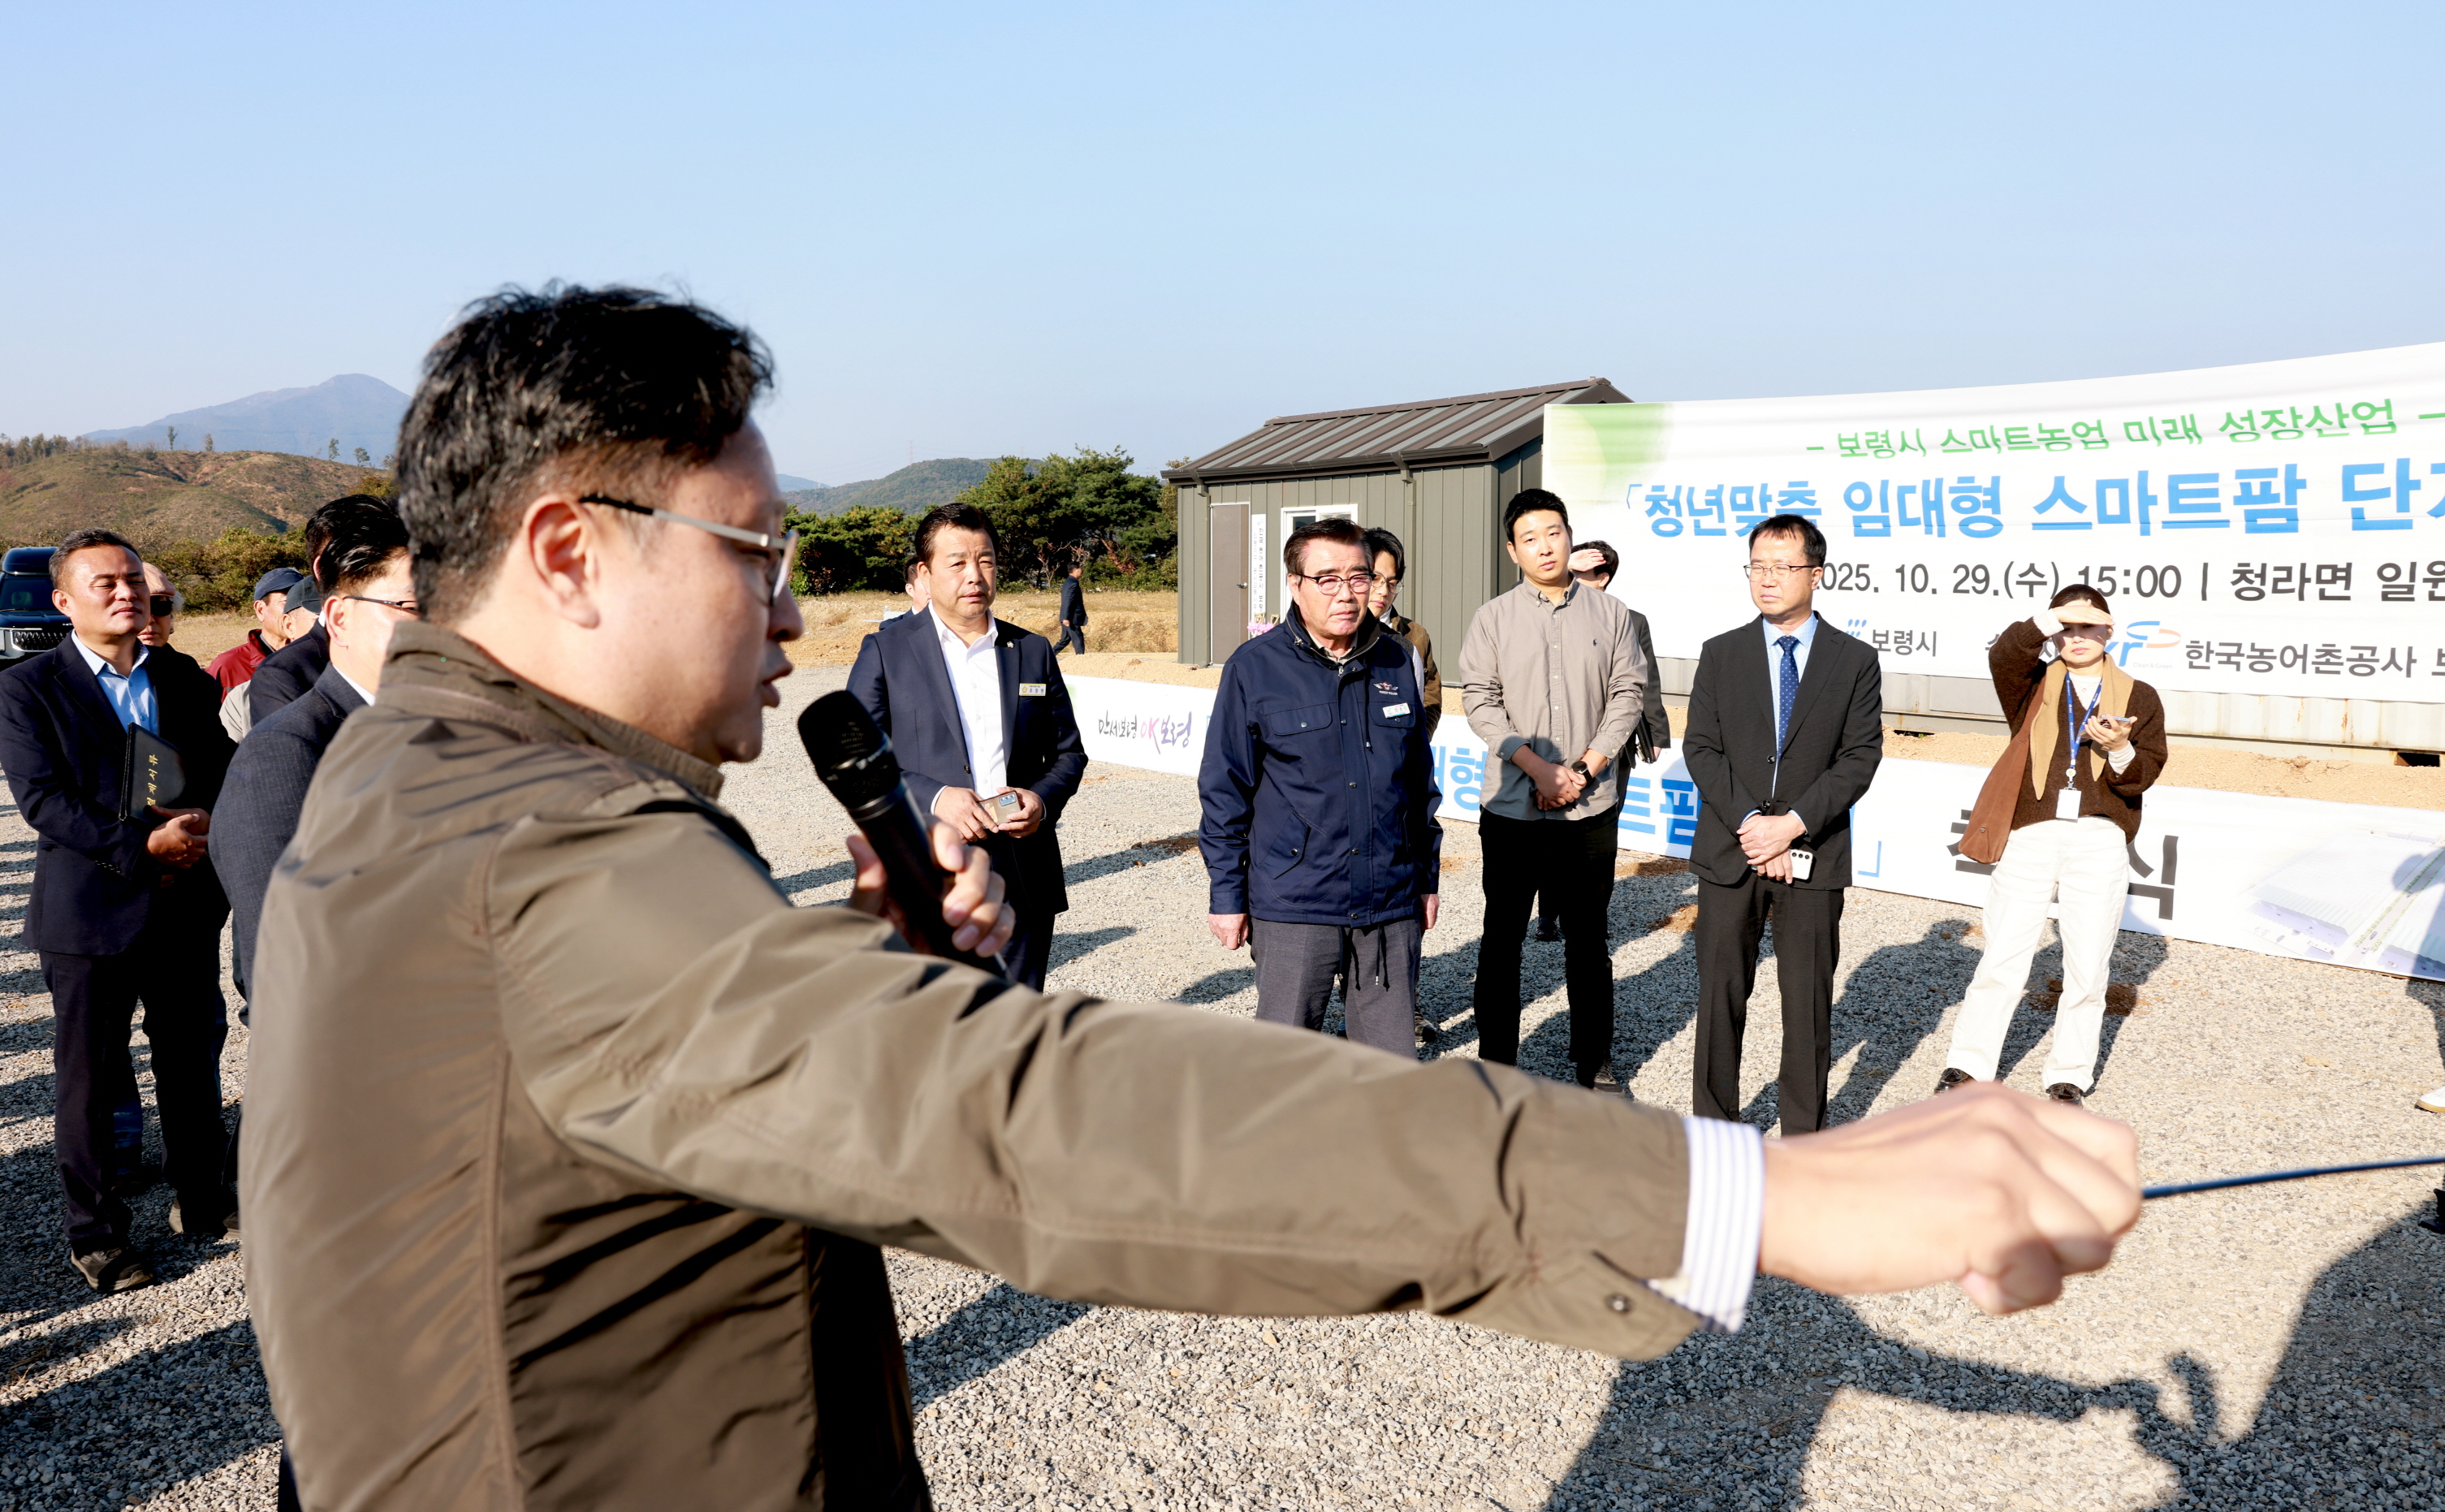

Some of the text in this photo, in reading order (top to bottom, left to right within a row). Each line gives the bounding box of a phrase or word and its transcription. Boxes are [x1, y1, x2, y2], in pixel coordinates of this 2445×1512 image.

[1838, 429, 1929, 460] 보령시
[1941, 420, 2111, 456] 스마트농업
[2123, 414, 2204, 447] 미래
[2219, 399, 2399, 443] 성장산업
[1843, 475, 2004, 538] 임대형
[2032, 464, 2308, 537] 스마트팜
[1816, 562, 1880, 594] 025.
[1894, 564, 1938, 595] 10.
[1952, 561, 2060, 599] 29.(수)
[2077, 564, 2182, 598] 15:00
[2230, 561, 2353, 602] 청라면
[1872, 629, 1937, 658] 보령시
[2185, 640, 2418, 678] 한국농어촌공사
[1098, 709, 1138, 739] 만세보령
